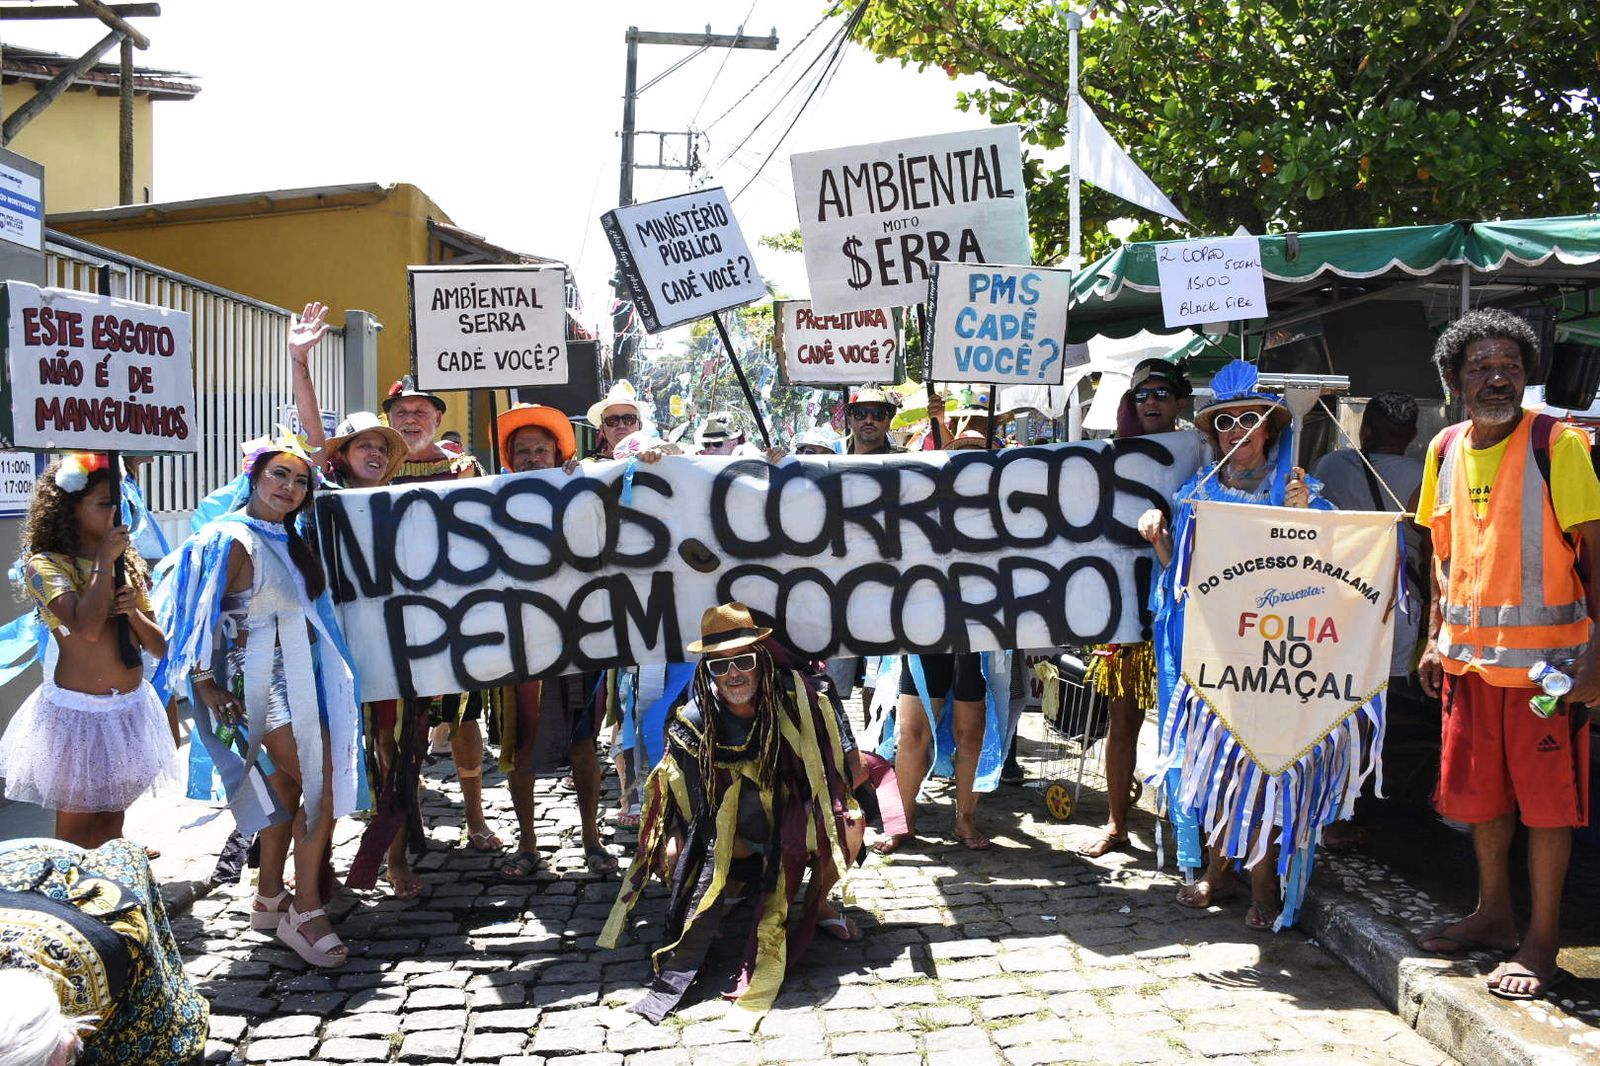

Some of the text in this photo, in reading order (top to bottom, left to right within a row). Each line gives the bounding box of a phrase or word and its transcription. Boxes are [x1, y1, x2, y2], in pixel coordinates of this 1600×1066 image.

[817, 144, 1015, 222] AMBIENTAL
[635, 201, 729, 248] MINISTÉRIO
[883, 216, 920, 233] MOTO
[658, 233, 723, 266] PÚBLICO
[1160, 247, 1176, 262] 2
[431, 282, 543, 311] AMBIENTAL
[661, 269, 703, 305] CADÊ
[968, 272, 1042, 306] PMS
[458, 312, 526, 334] SERRA
[954, 307, 1037, 341] CADÊ
[1180, 300, 1220, 316] BLACK
[23, 307, 174, 357] ESTE ESGOTO
[494, 343, 560, 371] VOCÊ?
[797, 338, 835, 365] CADÊ
[953, 337, 1060, 378] VOCÊ?
[39, 350, 154, 394] NÃO É DE
[35, 395, 188, 440] MANGUINHOS
[314, 437, 1175, 604] NOSSOS CORREGOS
[1270, 528, 1317, 540] BLOCO
[1198, 555, 1381, 604] DO SUCESSO PARALAMA
[383, 571, 685, 700] PEDEM
[1238, 612, 1339, 644] FOLIA
[1262, 640, 1313, 669] NO
[1198, 663, 1362, 704] LAMAÇAL
